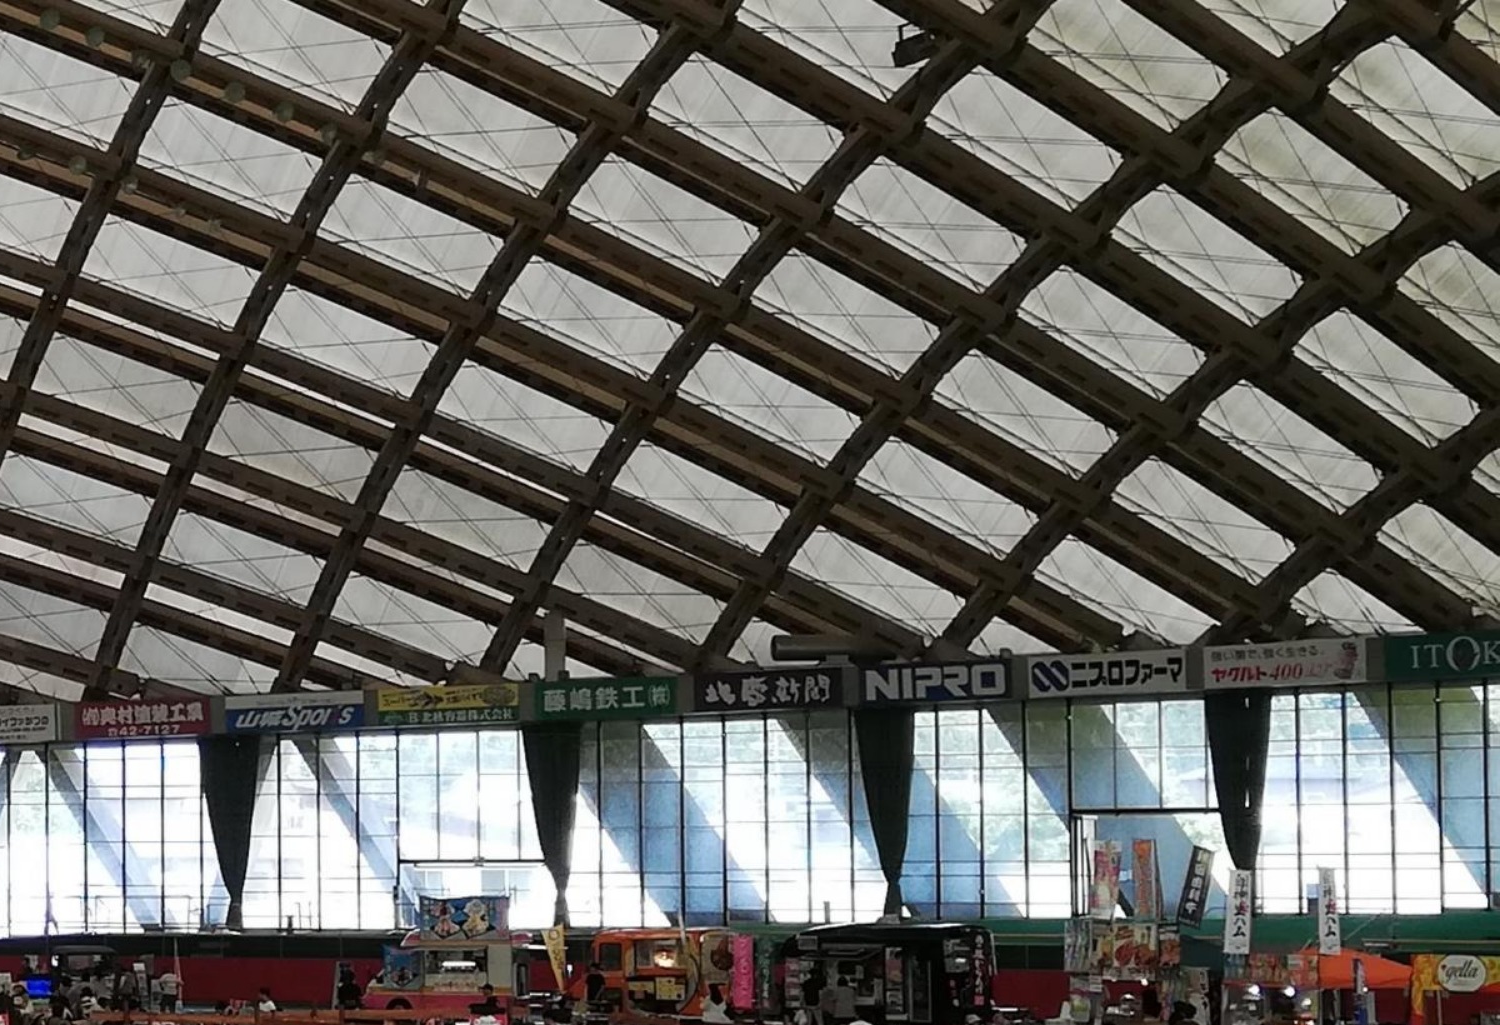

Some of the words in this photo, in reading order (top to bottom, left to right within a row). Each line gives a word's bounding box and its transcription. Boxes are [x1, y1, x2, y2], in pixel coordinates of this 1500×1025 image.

[865, 663, 1005, 701] NIPRO
[1071, 656, 1182, 688] ニプロファーマ
